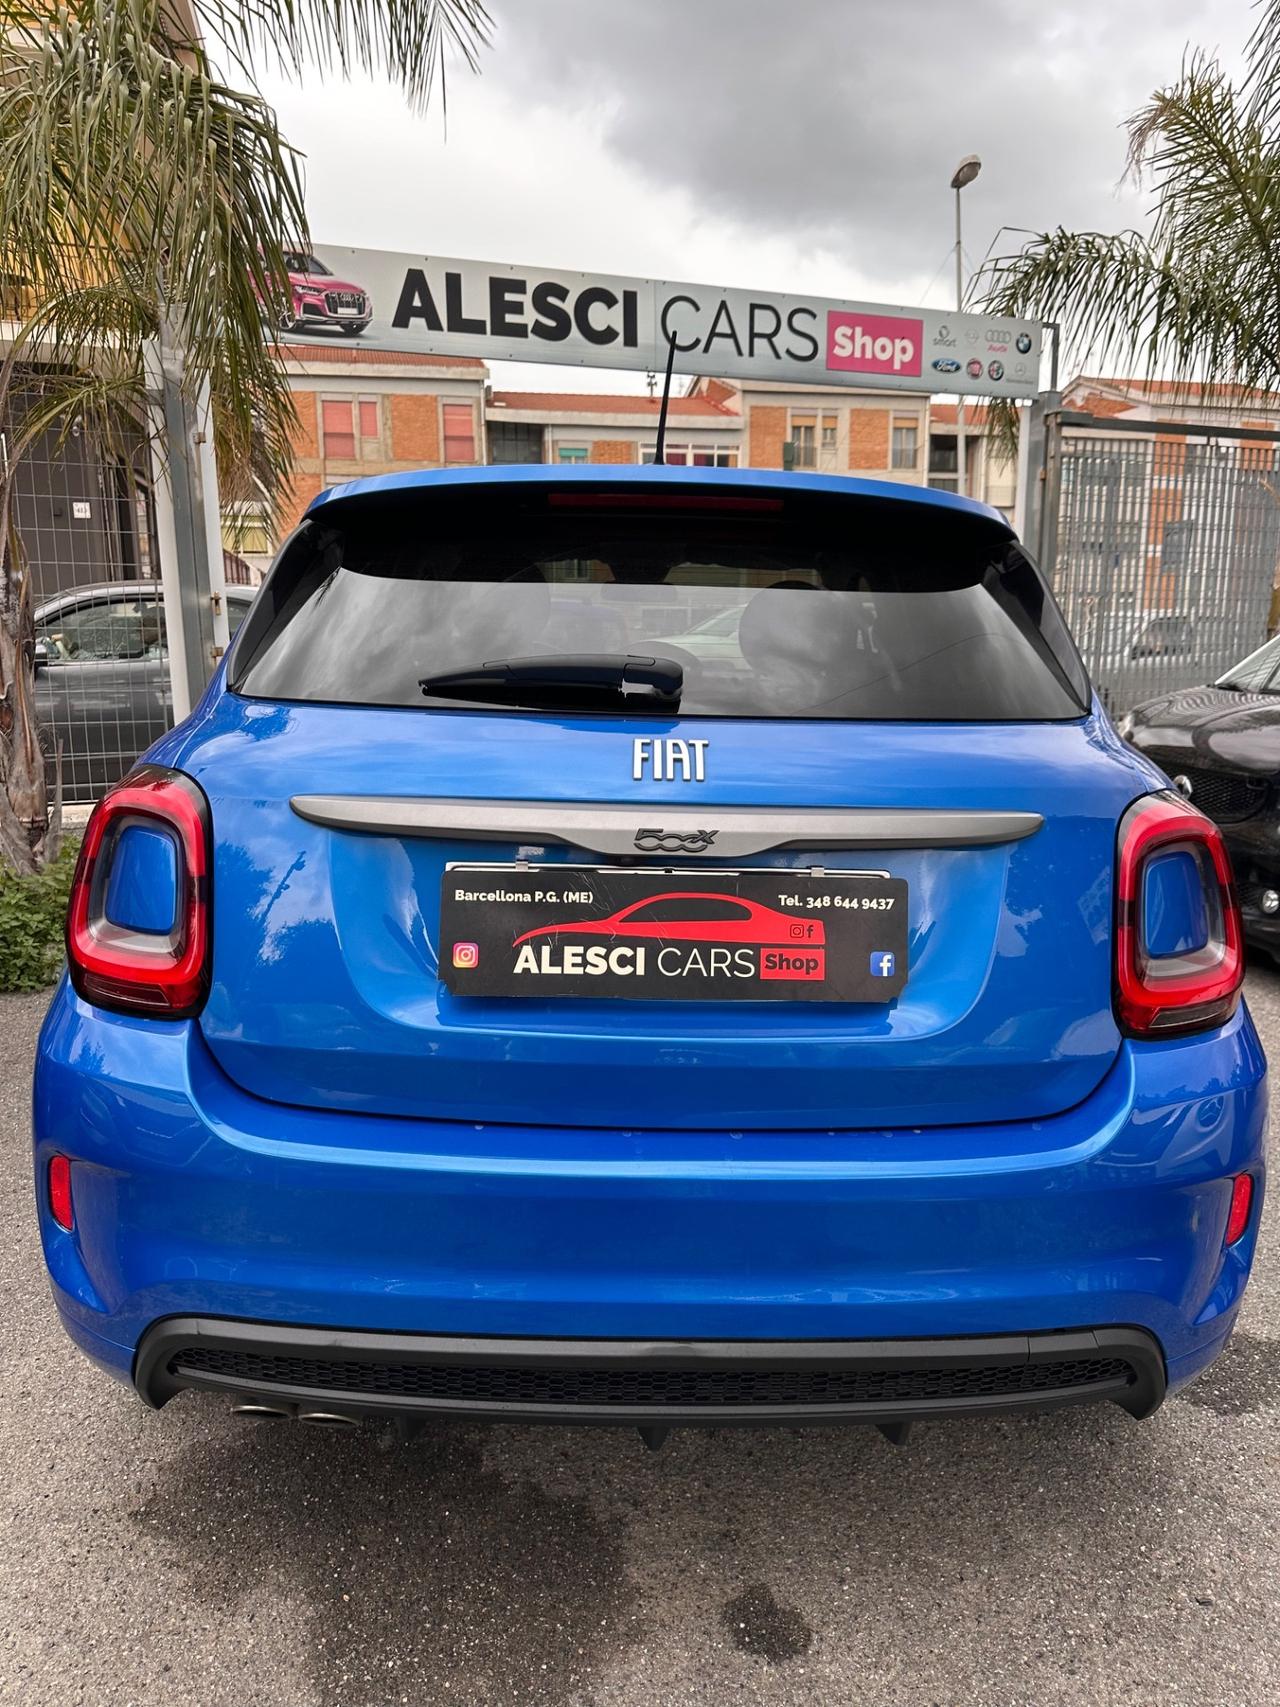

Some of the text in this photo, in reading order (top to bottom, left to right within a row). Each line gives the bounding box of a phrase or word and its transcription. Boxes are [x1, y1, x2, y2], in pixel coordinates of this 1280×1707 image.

[391, 268, 914, 370] ALESCI CARS Shop
[633, 738, 709, 782] FIAT
[454, 889, 594, 904] Barcellona P.G. (ME)
[778, 895, 895, 910] Tel. 348 644 9437
[513, 945, 819, 978] ALESCI CARS Shop
